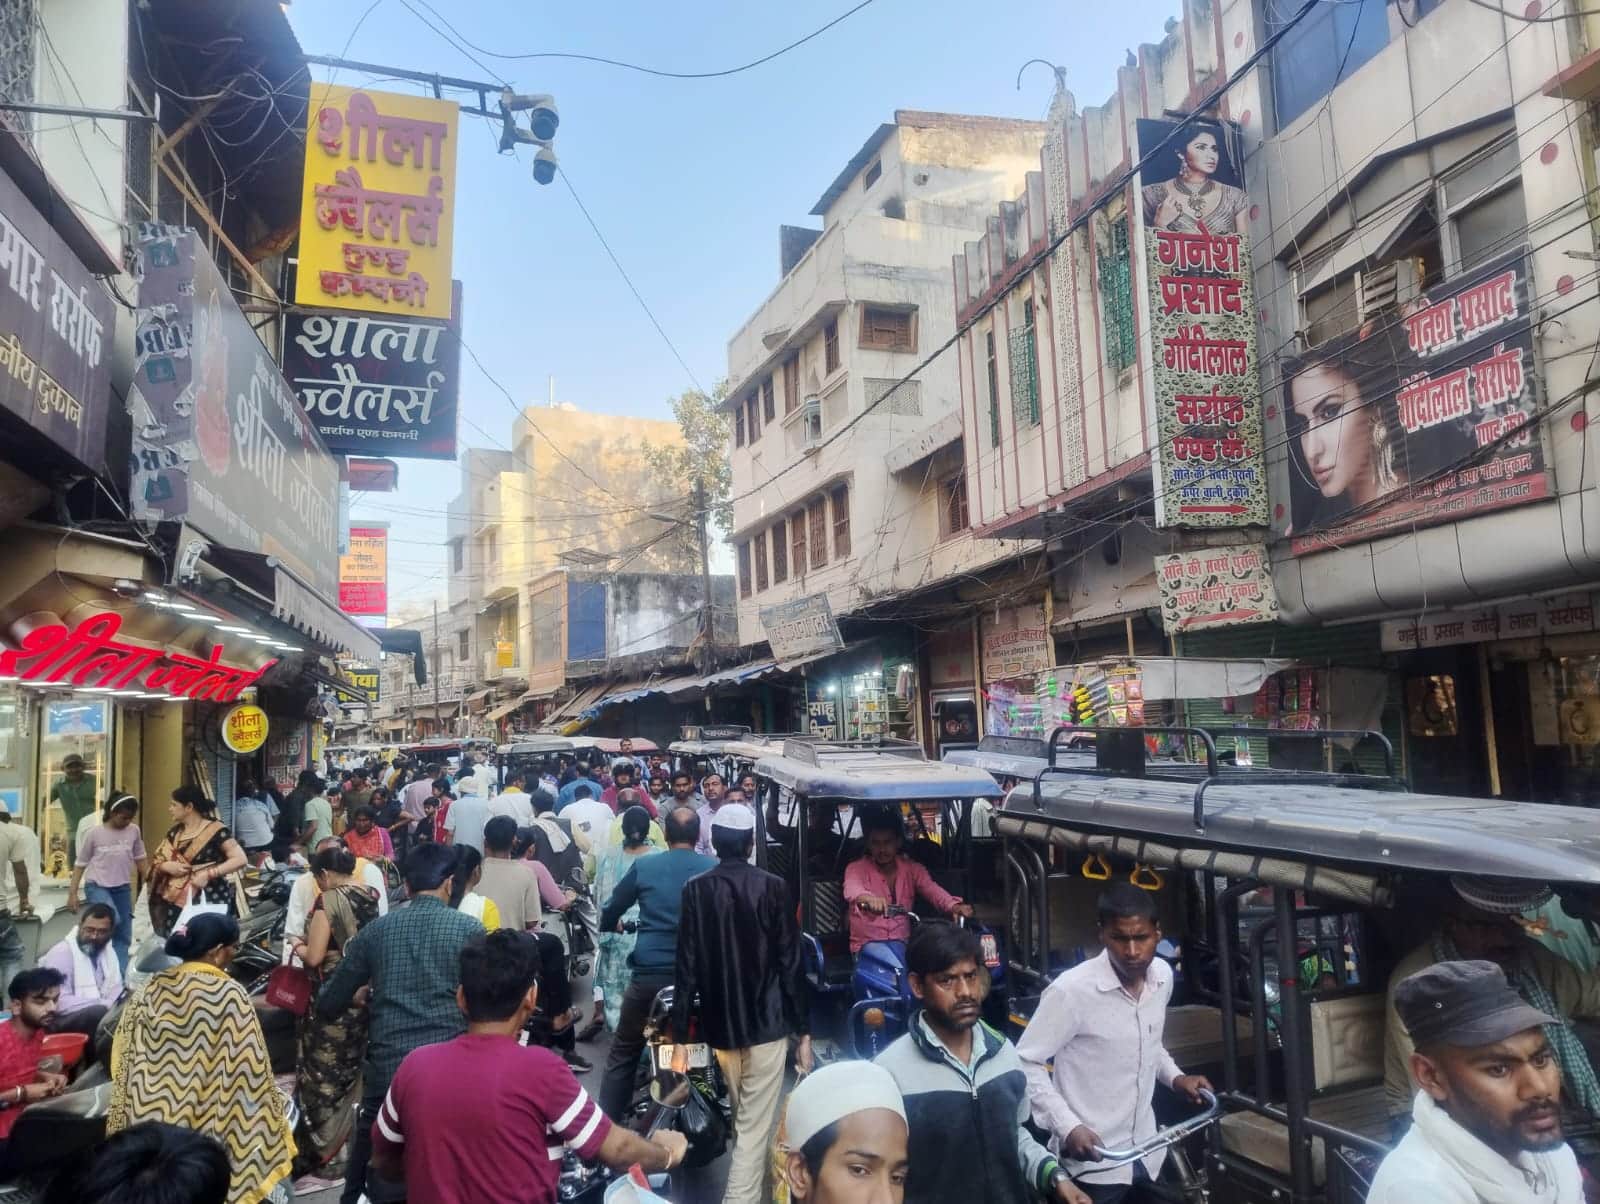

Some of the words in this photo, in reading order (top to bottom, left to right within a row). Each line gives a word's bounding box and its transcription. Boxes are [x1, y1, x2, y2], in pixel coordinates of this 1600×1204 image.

[318, 92, 448, 171] शीला
[1156, 221, 1241, 273] गनेश
[1159, 276, 1244, 316] प्रसाद
[38, 368, 82, 429] दुकान
[234, 374, 287, 504] शीला
[231, 710, 261, 729] शीला
